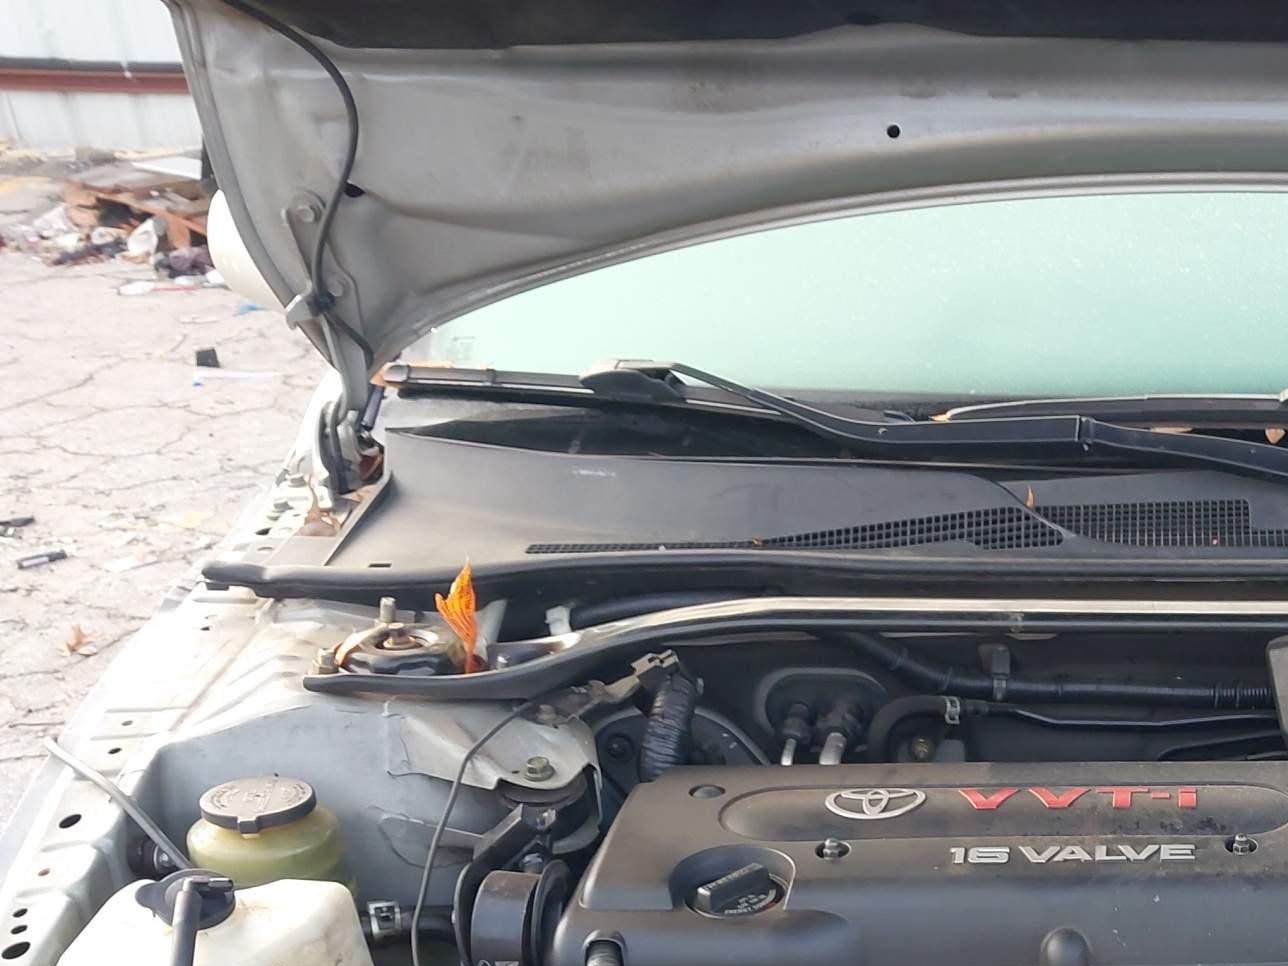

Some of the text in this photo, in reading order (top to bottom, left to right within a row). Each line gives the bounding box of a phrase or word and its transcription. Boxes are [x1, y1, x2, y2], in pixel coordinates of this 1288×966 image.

[958, 787, 1198, 809] VVT-i
[949, 844, 1197, 864] 16 VALVE
